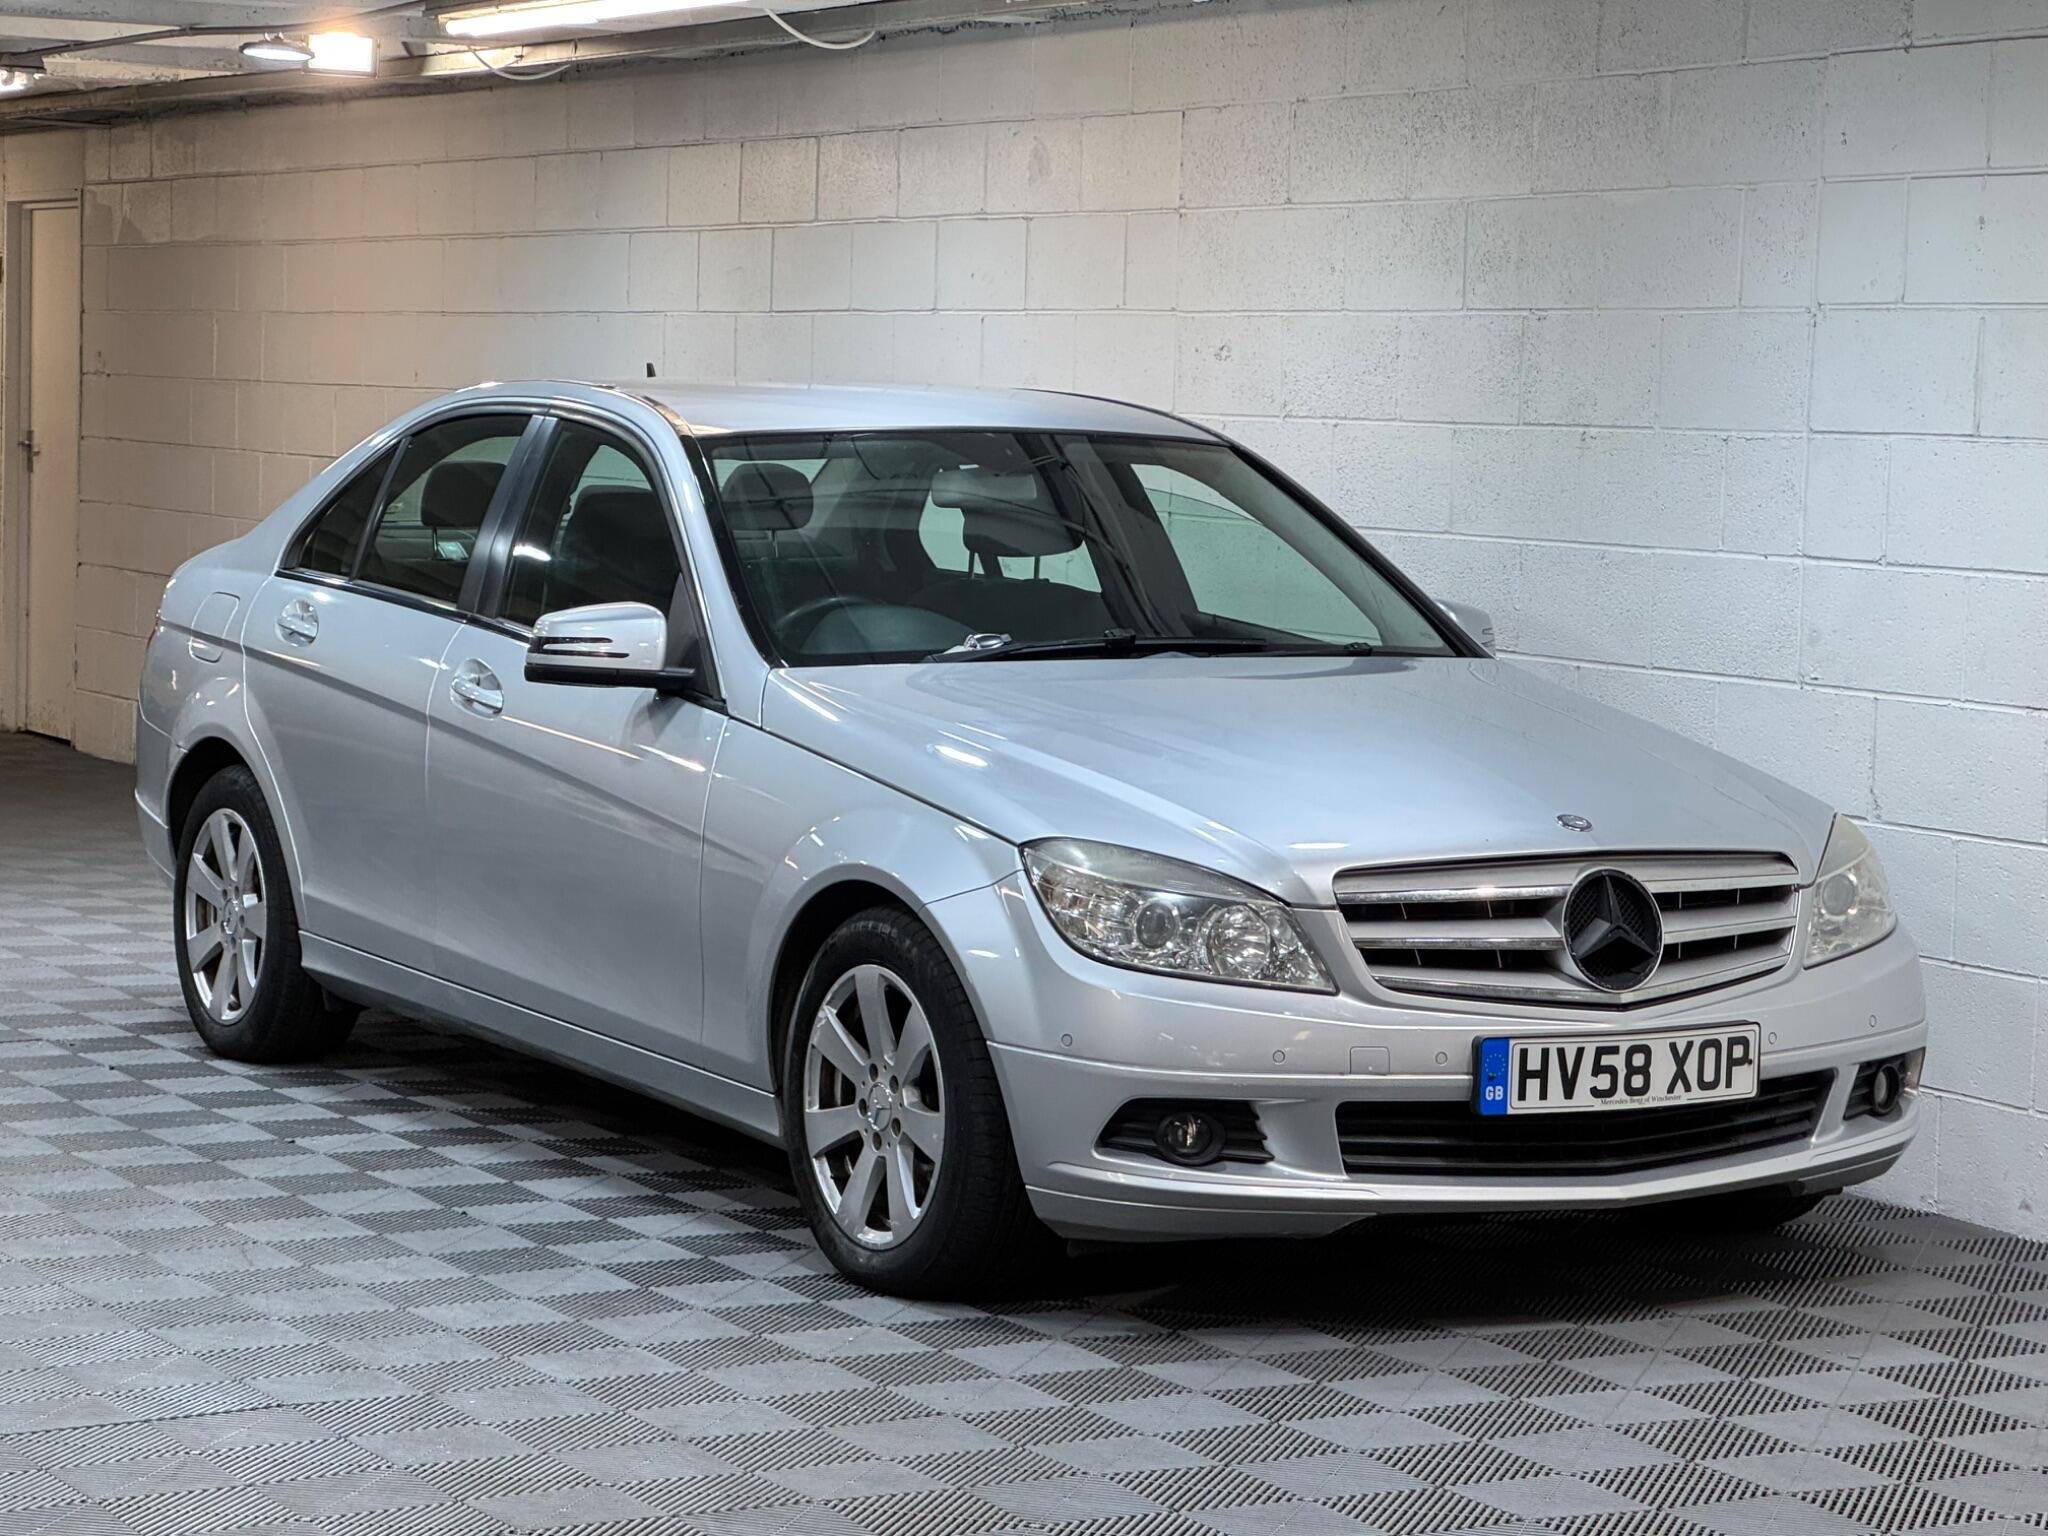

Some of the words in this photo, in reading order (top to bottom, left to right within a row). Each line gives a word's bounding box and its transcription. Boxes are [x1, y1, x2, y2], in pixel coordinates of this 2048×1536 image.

[1517, 1044, 1652, 1102] HV58
[1666, 1035, 1750, 1094] XOP
[1485, 1085, 1504, 1101] GB
